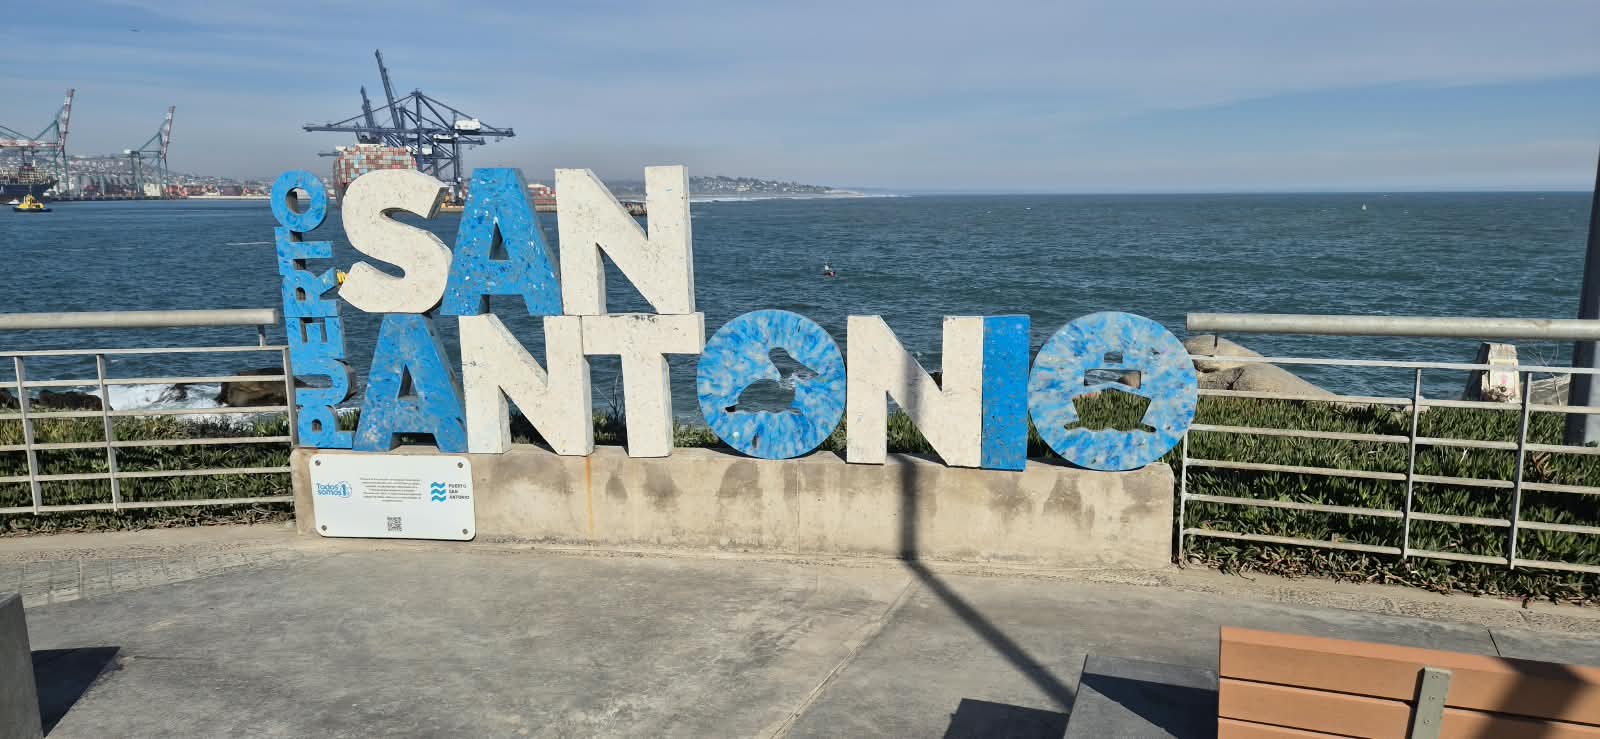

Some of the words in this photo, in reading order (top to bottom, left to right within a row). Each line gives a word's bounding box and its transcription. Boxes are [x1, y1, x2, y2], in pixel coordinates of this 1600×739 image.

[270, 169, 356, 449] PUERTO
[338, 165, 695, 316] SAN
[352, 309, 1198, 471] ANTONIO
[316, 482, 339, 490] Todos
